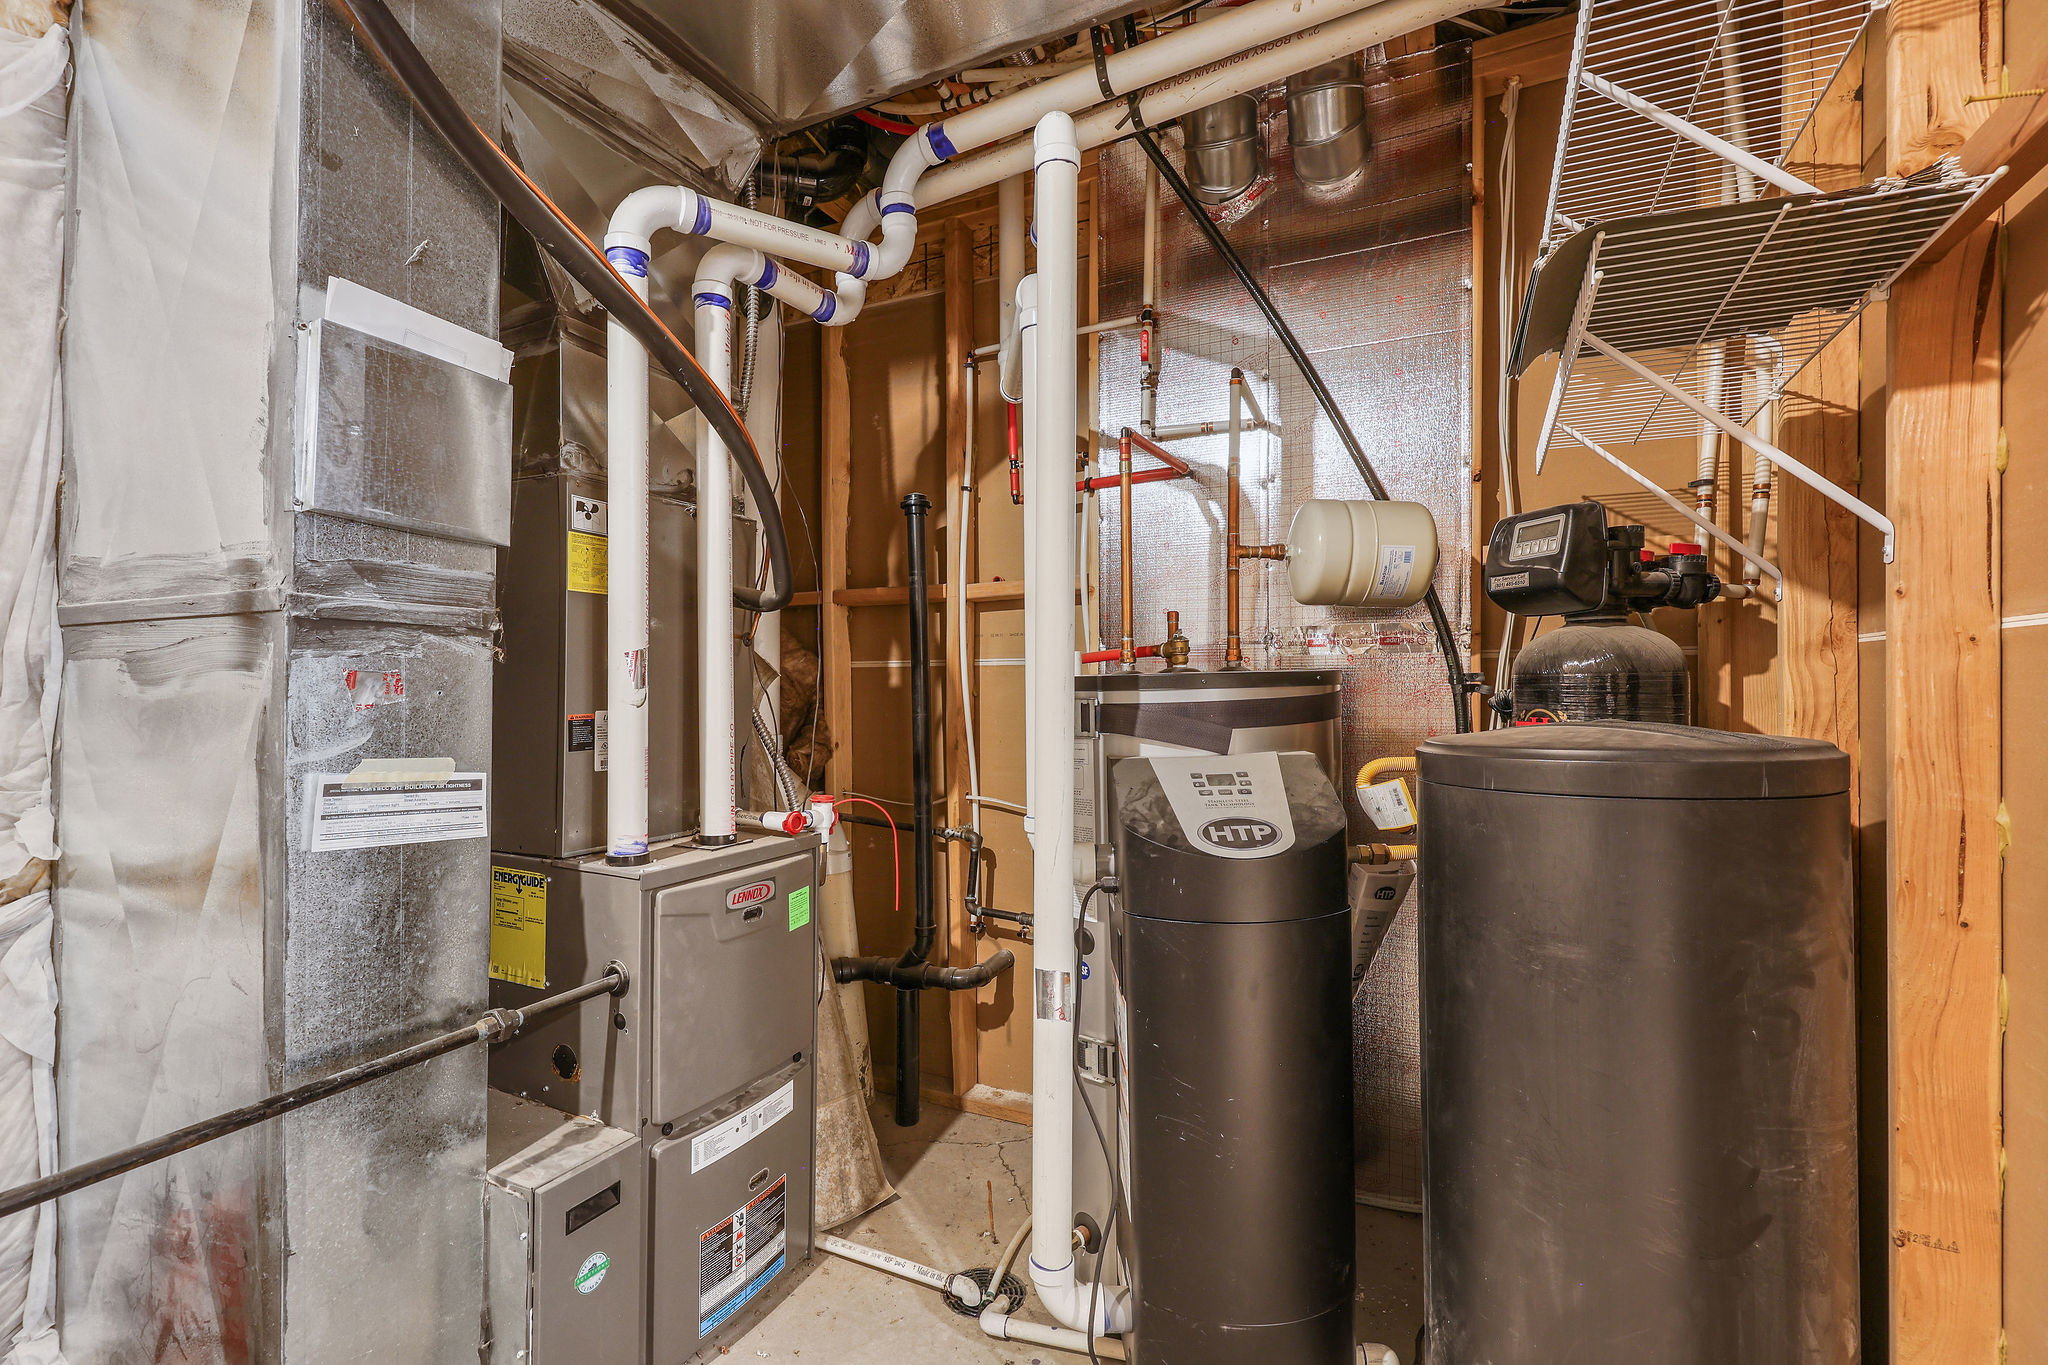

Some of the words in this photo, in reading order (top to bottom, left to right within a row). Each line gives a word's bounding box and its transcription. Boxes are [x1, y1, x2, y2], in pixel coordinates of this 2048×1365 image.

[1252, 36, 1291, 57] ROCKY
[1194, 50, 1250, 80] MOUNTAIN
[1157, 73, 1191, 92] COLBY
[750, 218, 763, 229] NOT
[763, 221, 777, 233] FOR
[777, 225, 810, 242] PRESSURE
[404, 783, 435, 791] BUILDING
[445, 782, 472, 790] TIGHTNESS
[1208, 824, 1273, 843] HTP
[731, 886, 764, 906] LENNOX
[1376, 889, 1396, 900] HTP
[916, 1264, 930, 1278] Made
[935, 1272, 945, 1283] the
